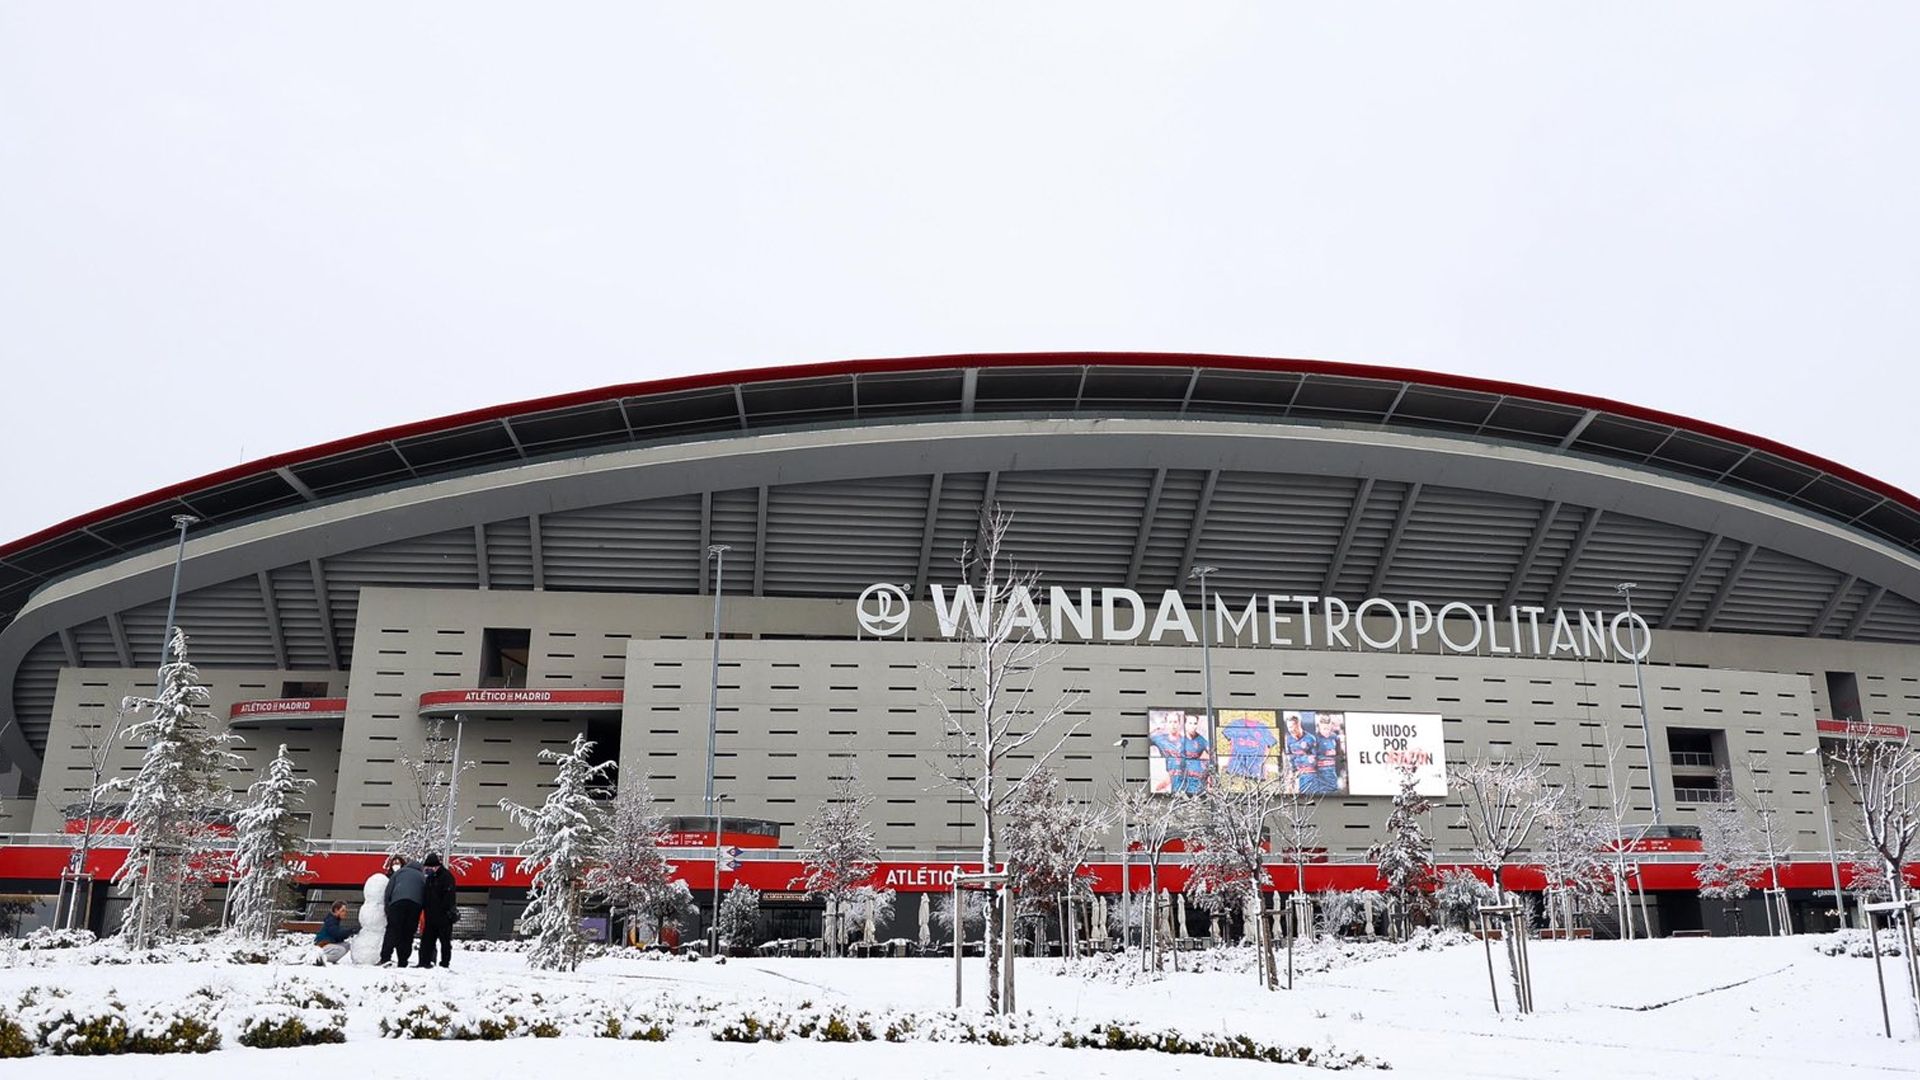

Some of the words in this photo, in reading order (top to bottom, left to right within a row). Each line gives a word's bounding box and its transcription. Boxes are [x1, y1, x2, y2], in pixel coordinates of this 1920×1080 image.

[930, 584, 1199, 643] WANDA
[1214, 591, 1652, 661] METROPOLITANO
[464, 689, 507, 701] ATLÉTICO
[514, 692, 551, 701] MADRID
[240, 701, 272, 713] ATLÉTICO
[279, 701, 311, 711] MADRID
[1372, 724, 1418, 738] UNIDOS
[1383, 738, 1408, 751] POR
[1359, 751, 1372, 764] EL
